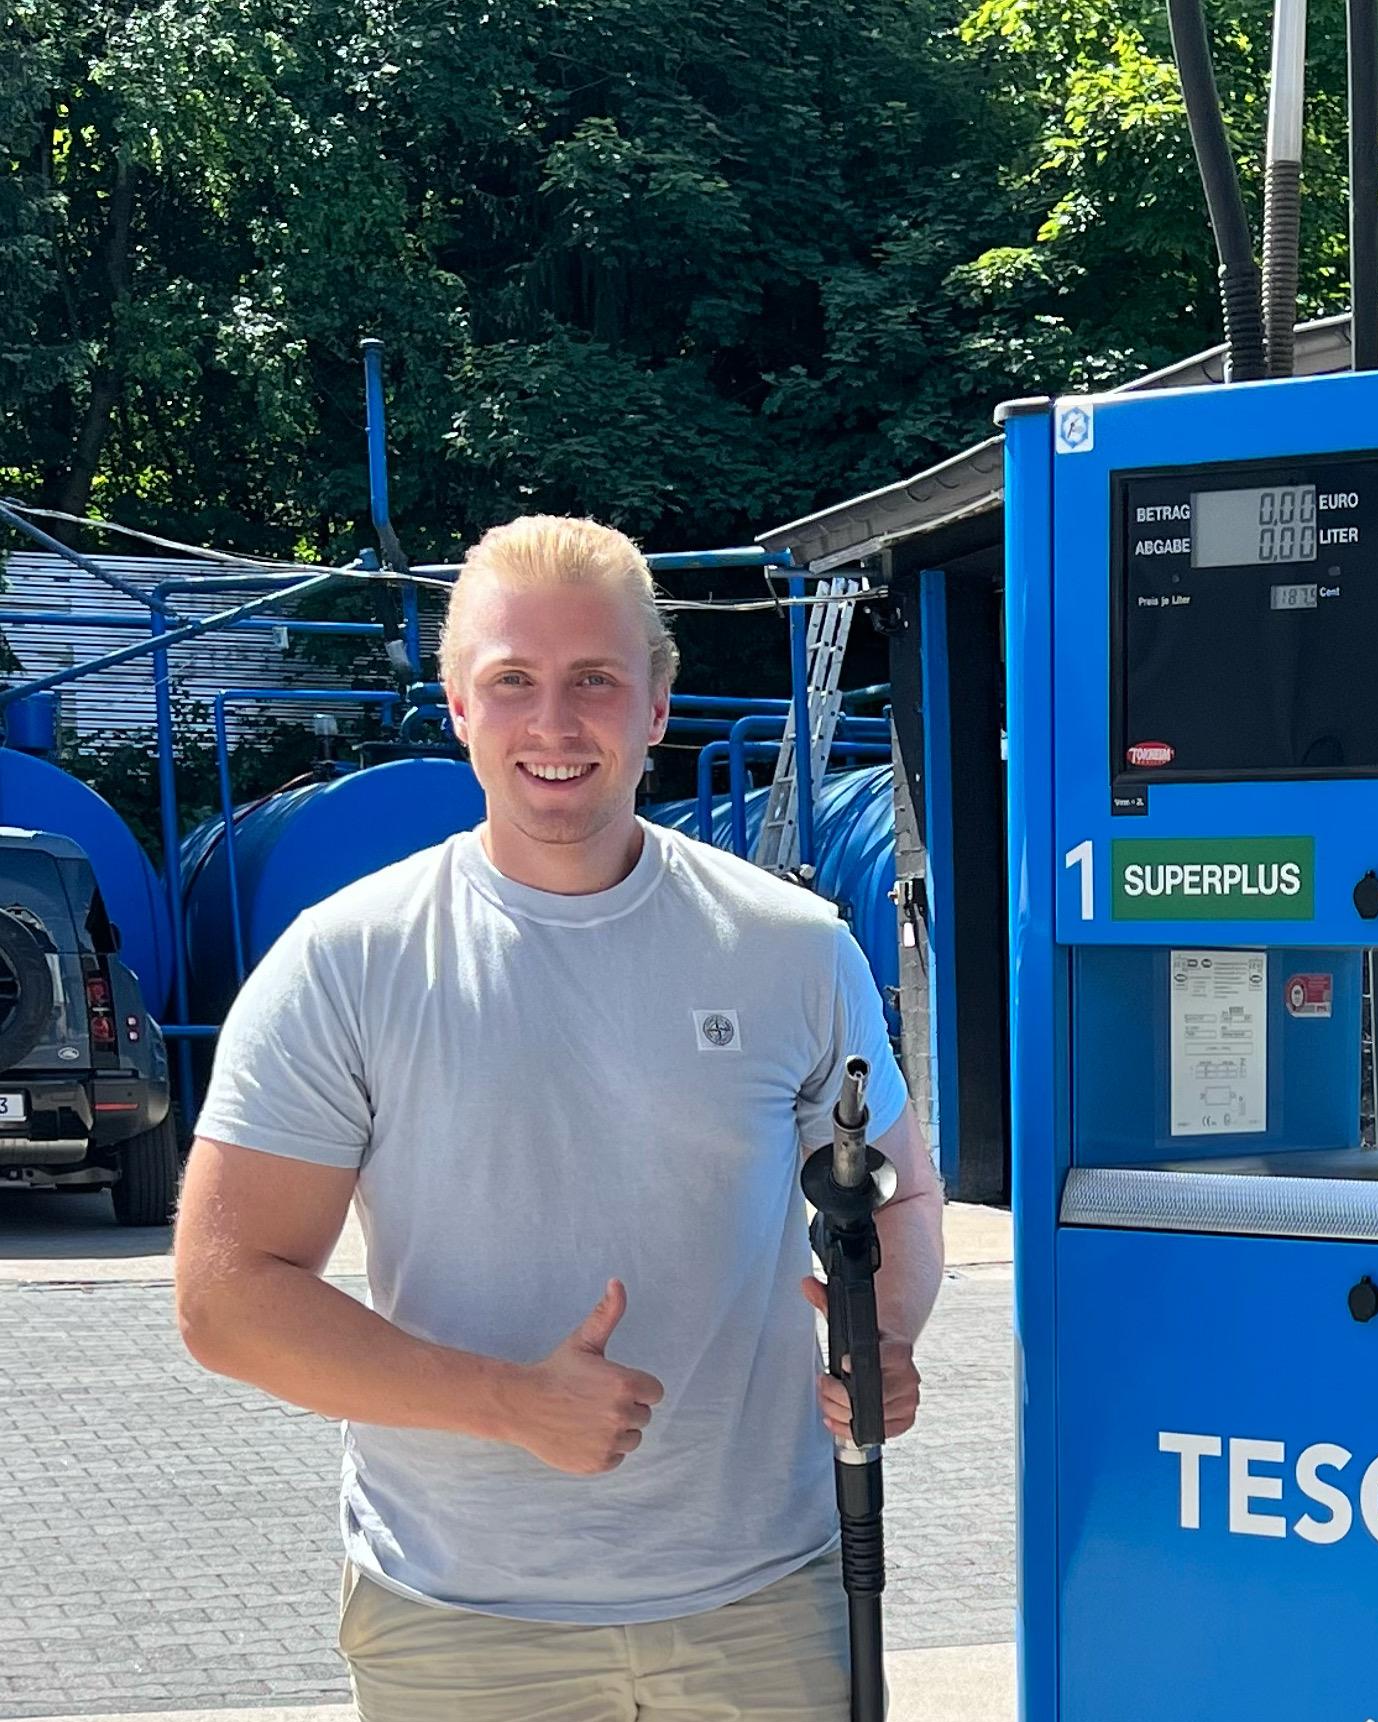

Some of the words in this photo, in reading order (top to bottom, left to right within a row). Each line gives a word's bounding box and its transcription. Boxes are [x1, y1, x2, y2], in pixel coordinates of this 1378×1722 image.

[1319, 493, 1359, 510] EURO
[1136, 504, 1191, 522] BETRAG
[1319, 527, 1359, 544] LITER
[1135, 538, 1191, 555] ABGABE
[1171, 595, 1191, 605] Liter
[1319, 586, 1340, 597] Cent
[1065, 840, 1094, 921] 1
[1123, 862, 1301, 896] SUPERPLUS
